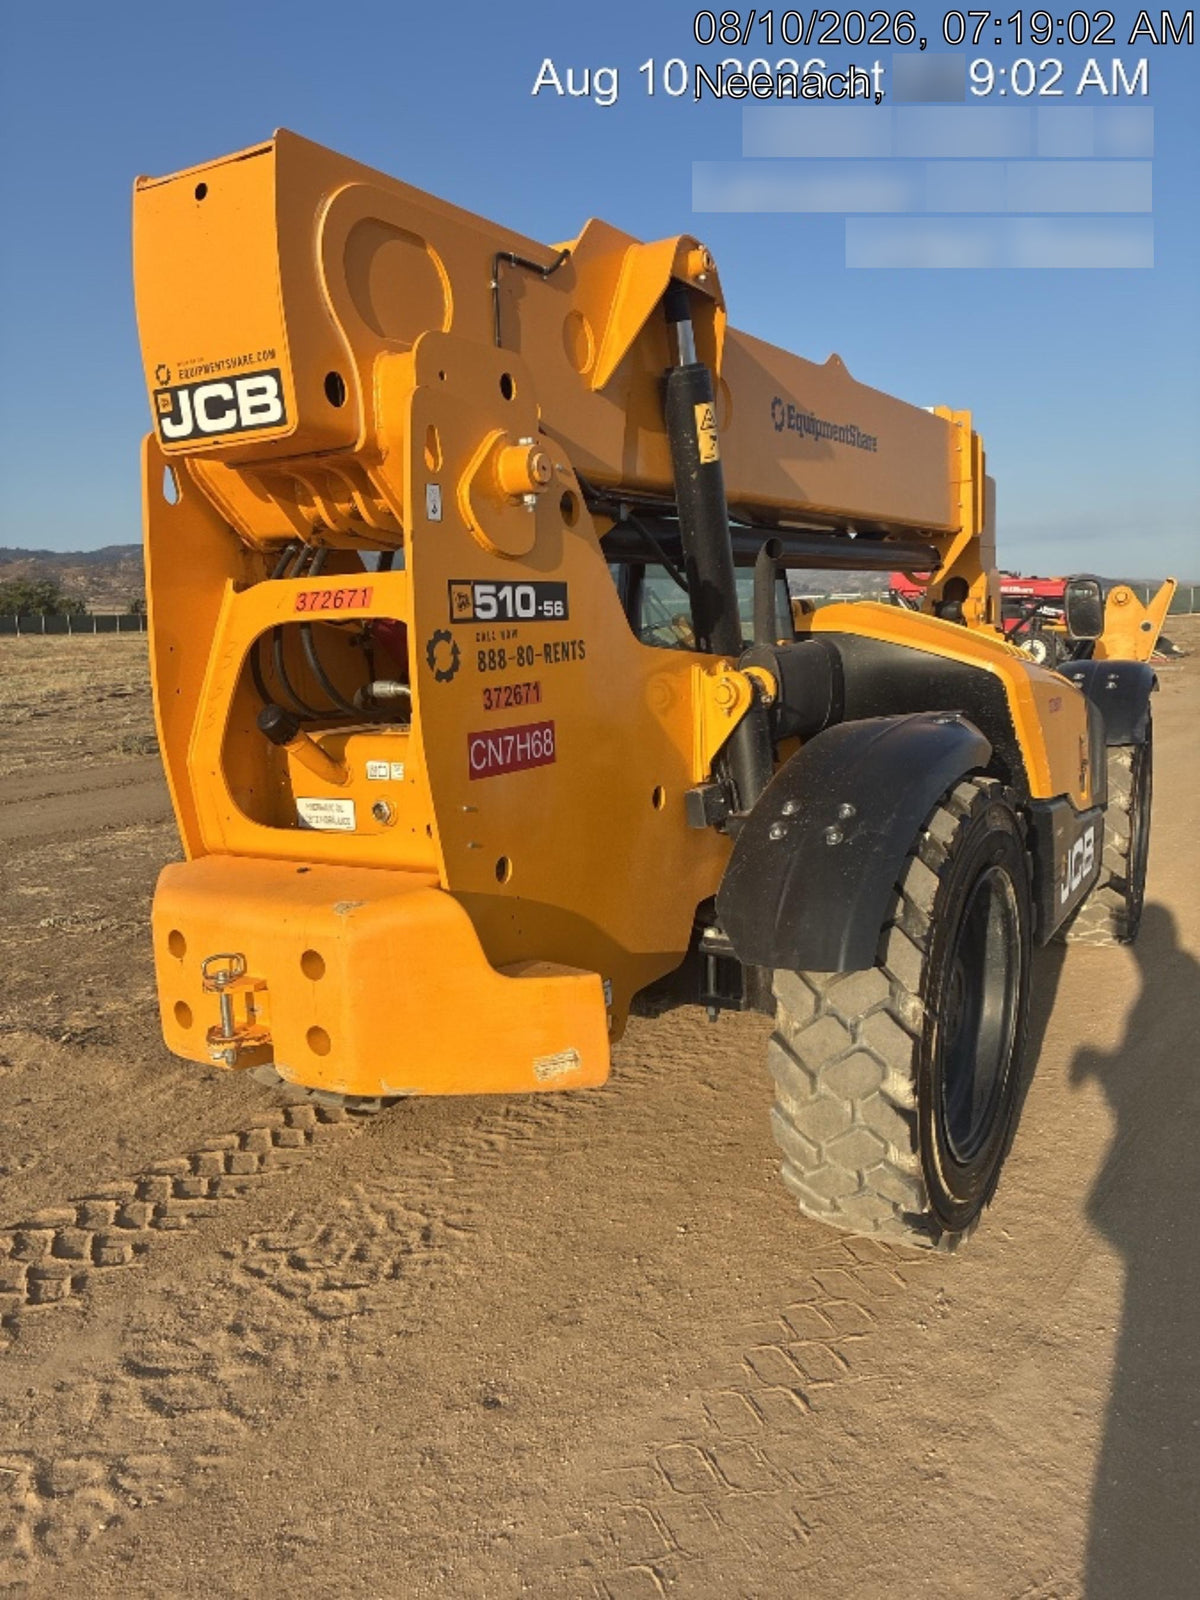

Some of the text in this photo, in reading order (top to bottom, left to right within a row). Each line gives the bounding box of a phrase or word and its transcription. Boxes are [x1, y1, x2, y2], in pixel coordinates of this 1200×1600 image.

[178, 348, 276, 380] EQUIPMENTSHARE.COM
[161, 374, 283, 438] JCB
[786, 404, 878, 453] EquipmentShare
[296, 587, 369, 612] 372671
[477, 639, 586, 673] 888-80-RENTS
[483, 681, 541, 711] 372671
[470, 728, 554, 770] CN7H68
[1060, 825, 1095, 904] JCB
